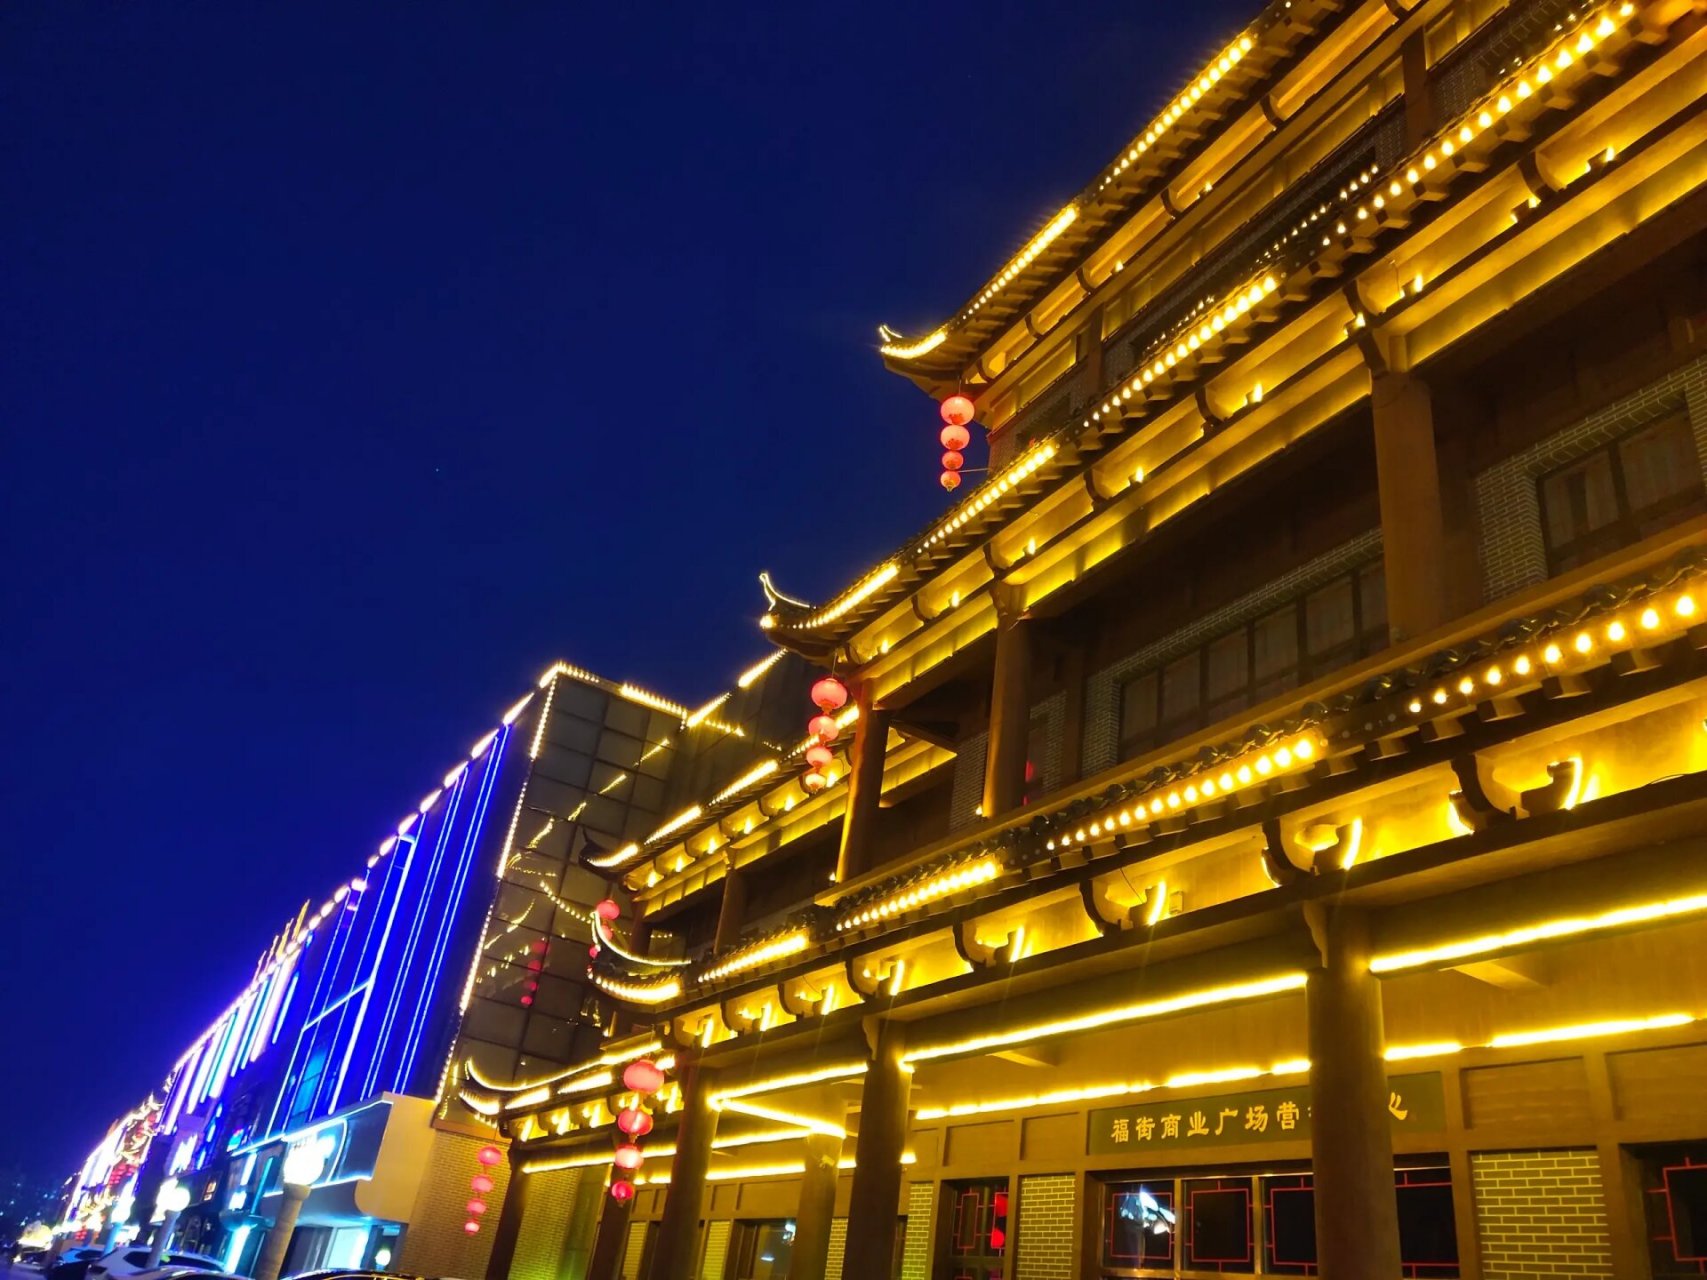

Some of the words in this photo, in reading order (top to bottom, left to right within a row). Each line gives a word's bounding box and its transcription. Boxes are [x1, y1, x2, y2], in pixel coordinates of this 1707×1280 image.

[1110, 1091, 1408, 1144] 福街商业广场营心
